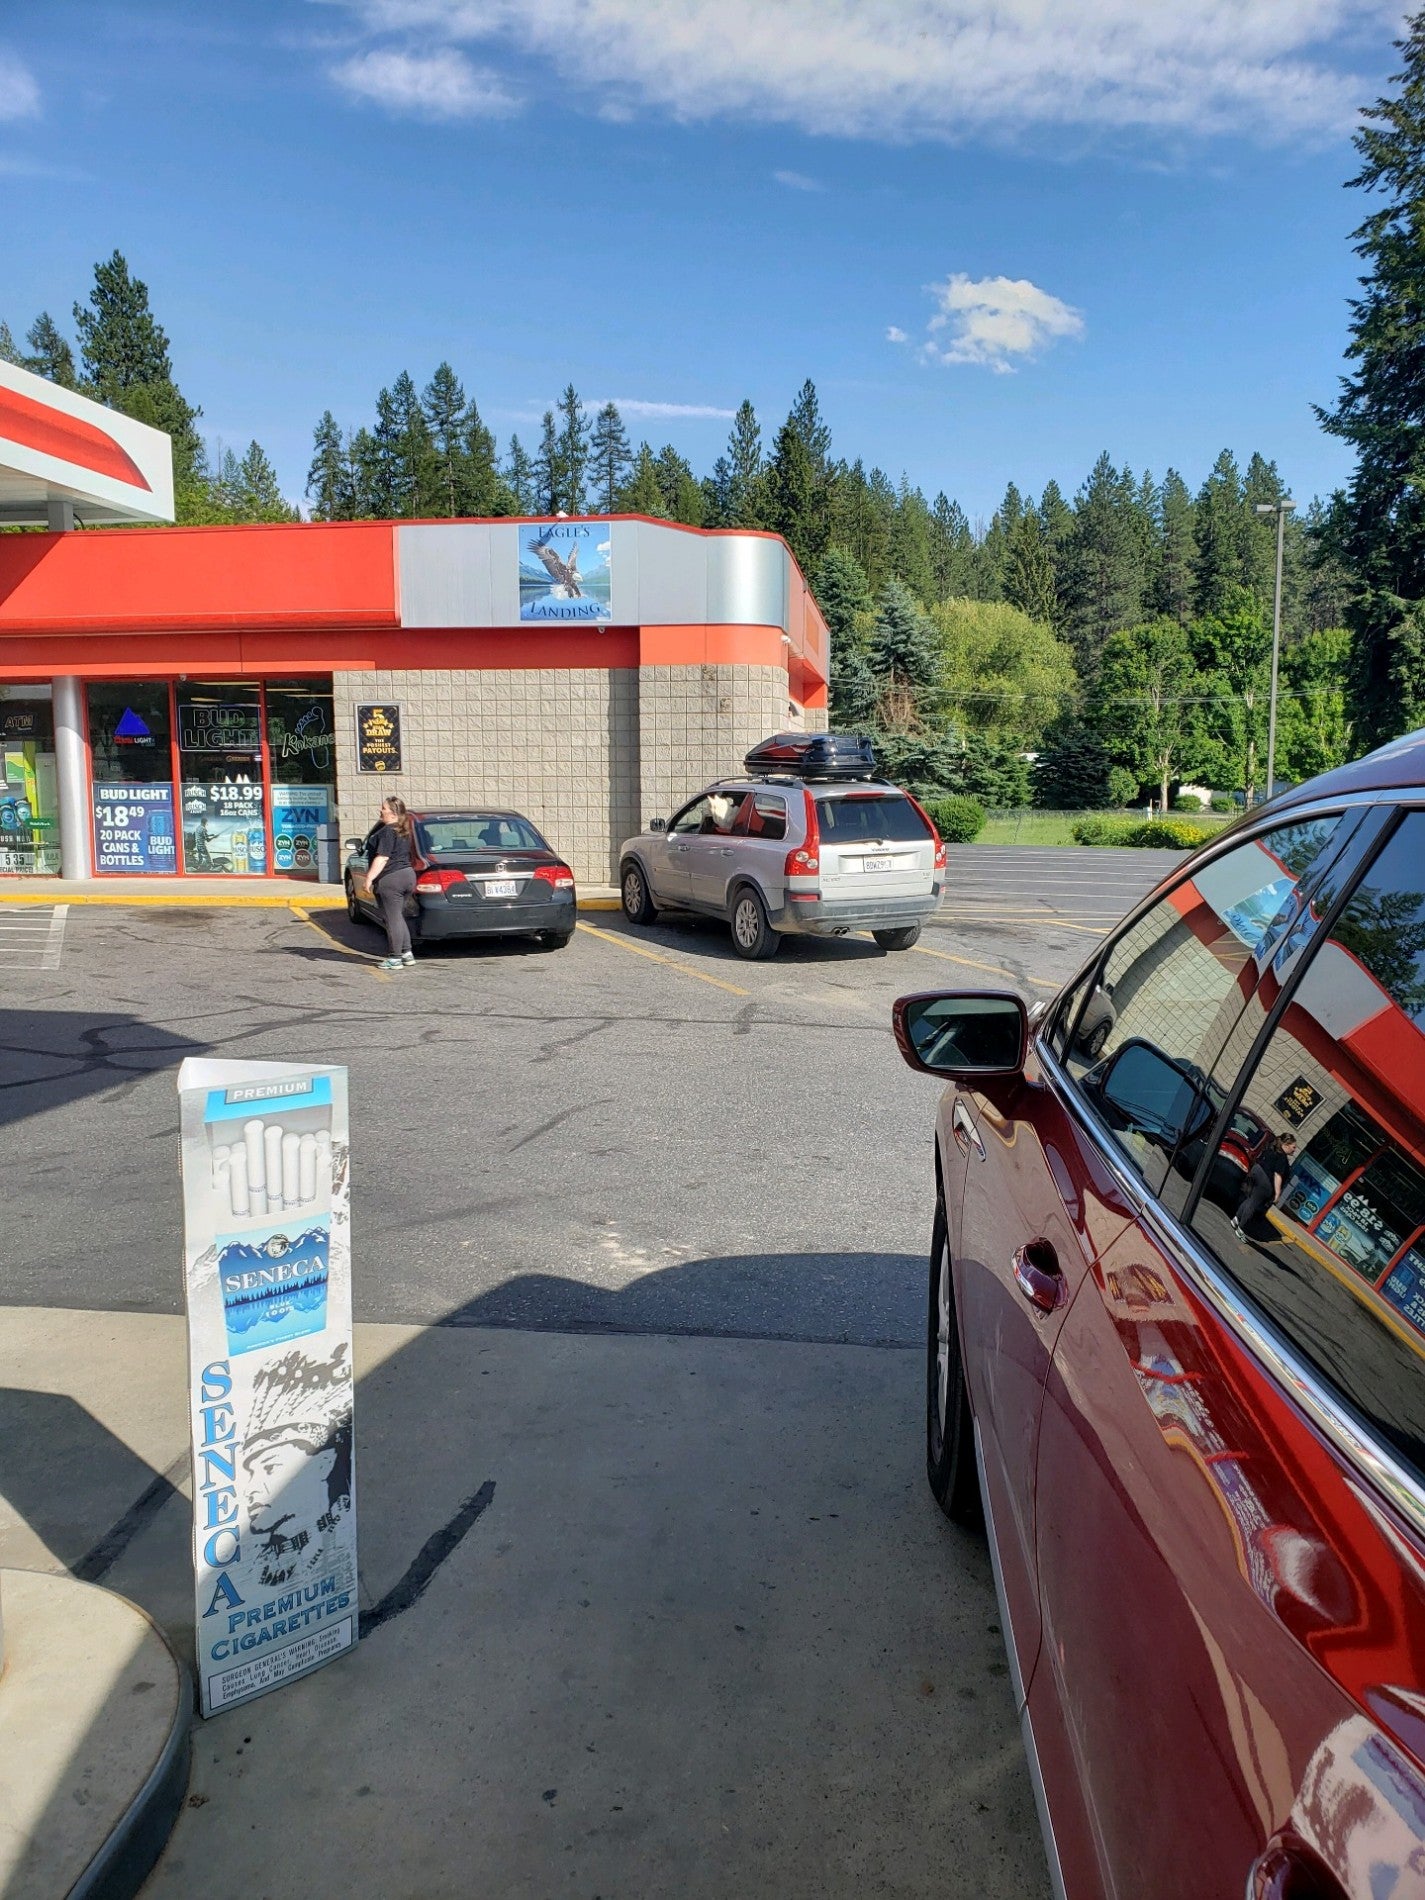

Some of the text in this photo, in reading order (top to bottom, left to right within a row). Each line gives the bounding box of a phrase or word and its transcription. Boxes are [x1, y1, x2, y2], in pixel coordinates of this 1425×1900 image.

[539, 525, 591, 538] EAGLE'S
[530, 601, 601, 618] LANDING
[4, 714, 34, 728] ATM
[193, 709, 246, 728] BUD
[373, 708, 385, 721] 5
[185, 728, 258, 748] LIGHT
[282, 732, 335, 757] Kokane
[100, 789, 169, 800] BUD LIGHT
[210, 785, 263, 802] $18.99
[281, 808, 320, 823] ZYN
[100, 830, 142, 840] 20 PACK
[150, 836, 173, 845] BUD
[102, 842, 140, 853] CANS &
[148, 845, 175, 855] LIGHT
[100, 855, 144, 866] BOTTLES
[233, 1081, 307, 1100] PREMIUM
[225, 1255, 325, 1294] SENECA
[199, 1360, 245, 1618] SENECA
[228, 1575, 336, 1634] PREMIUM
[211, 1590, 351, 1660] CIGARETTES
[222, 1666, 252, 1684] SURGEON
[254, 1652, 287, 1671] GENERAL'S
[222, 1678, 245, 1692] Causes
[249, 1671, 266, 1682] Lung
[259, 1675, 270, 1685] And
[273, 1669, 285, 1679] May
